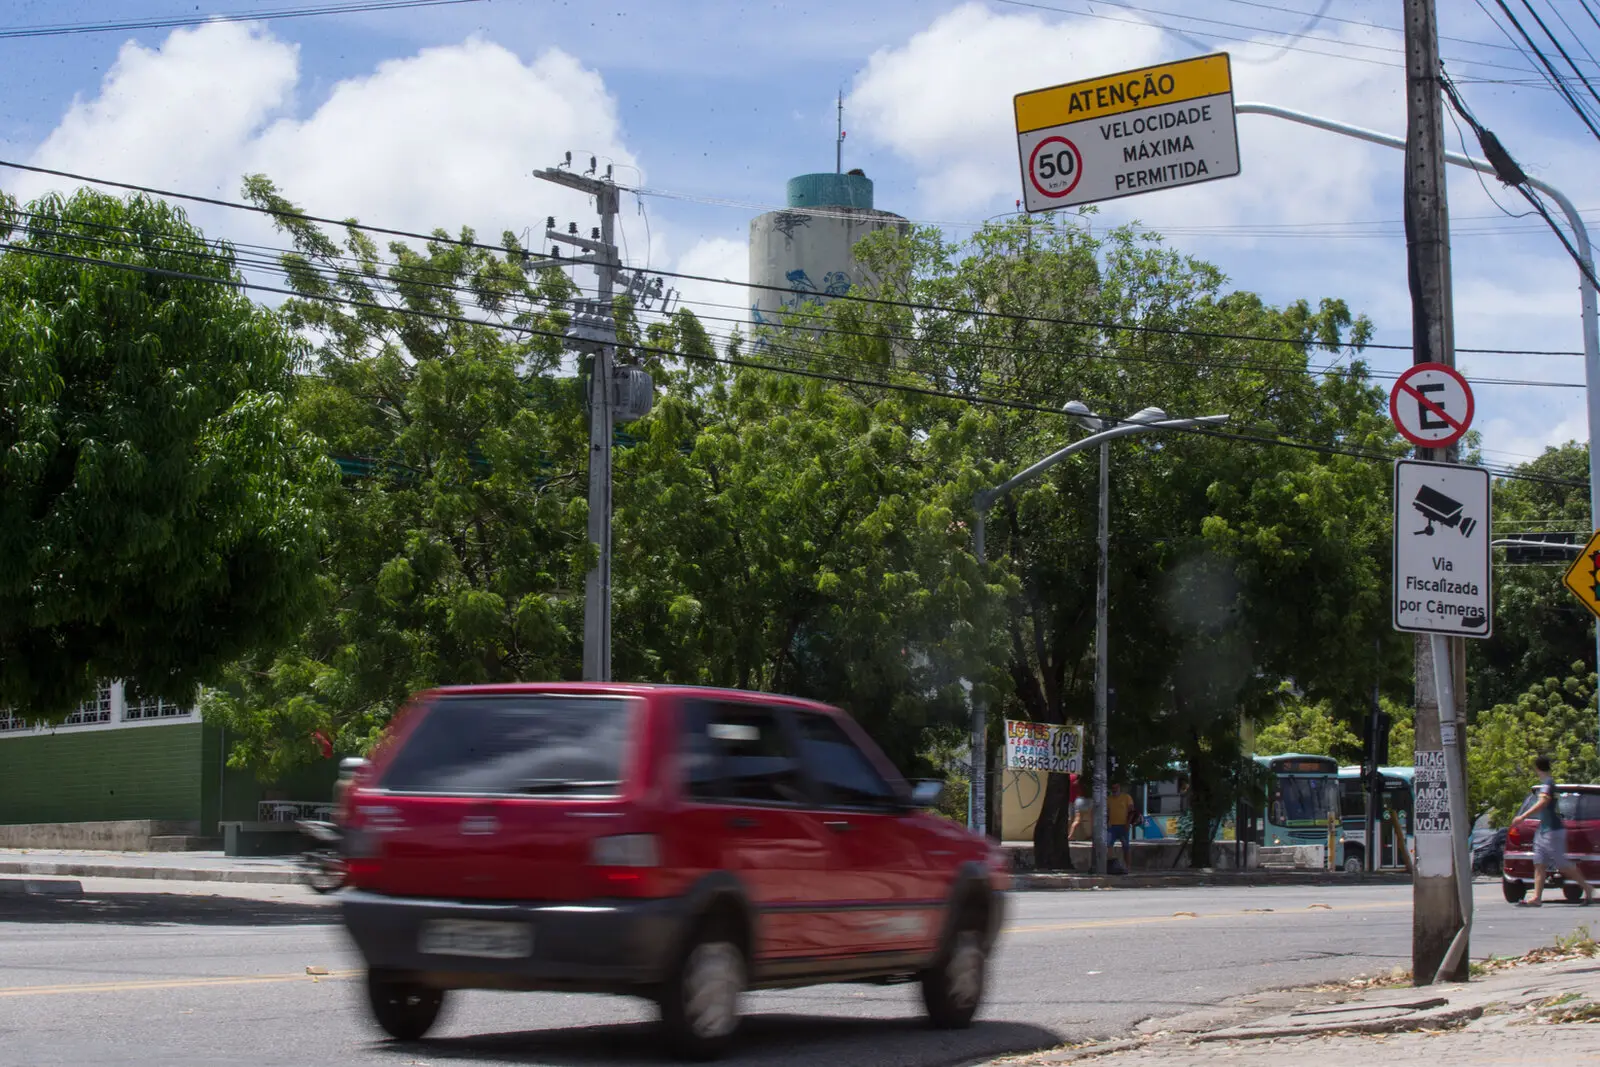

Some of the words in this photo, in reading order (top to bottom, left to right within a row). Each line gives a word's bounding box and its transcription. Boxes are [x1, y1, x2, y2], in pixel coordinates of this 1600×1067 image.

[1067, 73, 1175, 114] ATENÇÃO
[1100, 104, 1212, 140] VELOCIDADE
[1123, 135, 1194, 163] MÁXIMA
[1039, 150, 1074, 180] 50
[1115, 159, 1209, 191] PERMITIDA
[1416, 383, 1449, 430] E
[1432, 556, 1453, 572] Via
[1406, 576, 1479, 596] Fiscalizada
[1400, 600, 1422, 613] por
[1426, 600, 1485, 618] Câmeras
[1007, 721, 1050, 740] LOTES
[1015, 746, 1049, 758] PRAIAS
[1415, 752, 1445, 766] TRAG
[1416, 819, 1451, 830] VOLTA
